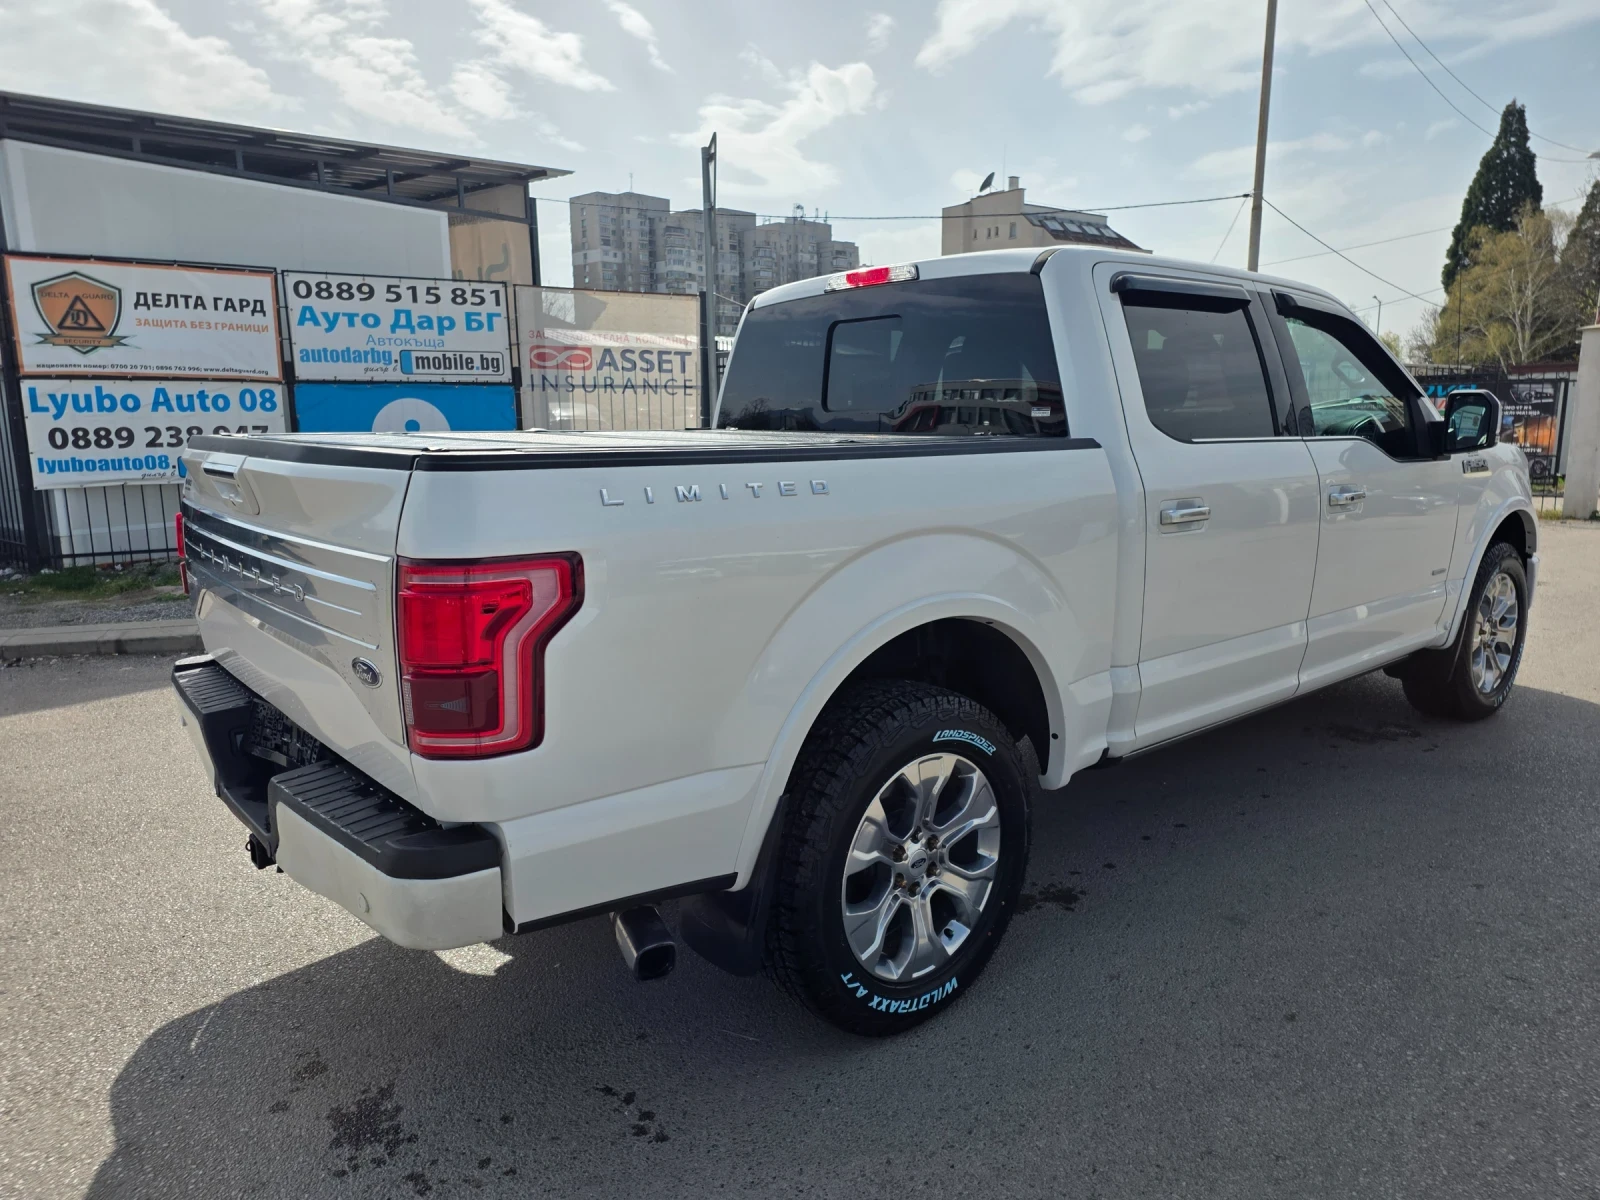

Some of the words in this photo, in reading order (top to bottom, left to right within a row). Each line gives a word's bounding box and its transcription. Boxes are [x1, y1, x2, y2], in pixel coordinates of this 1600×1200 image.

[41, 291, 69, 299] DELTA
[134, 292, 207, 310] ДЕЛТА
[213, 297, 266, 317] ГАРД
[293, 280, 375, 301] 0889
[385, 284, 441, 304] 515
[450, 287, 501, 307] 851
[135, 318, 187, 329] ЗАЩИТА
[190, 320, 212, 330] БЕЗ
[215, 322, 269, 334] ГРАНИЦИ
[297, 305, 381, 333] Ауто
[389, 308, 456, 336] Дар
[464, 311, 502, 332] БГ
[415, 353, 501, 373] mobile.bg
[597, 348, 692, 374] ASSET
[530, 374, 693, 397] INSURANCE
[27, 385, 141, 421] Lyubo
[151, 387, 231, 413] Auto
[239, 388, 277, 413] 08
[48, 426, 135, 450] 0889
[600, 479, 830, 507] LIMITED
[932, 729, 997, 756] LANDSPIDER
[840, 972, 869, 999] A/T
[868, 976, 958, 1013] WILDTRAXX
